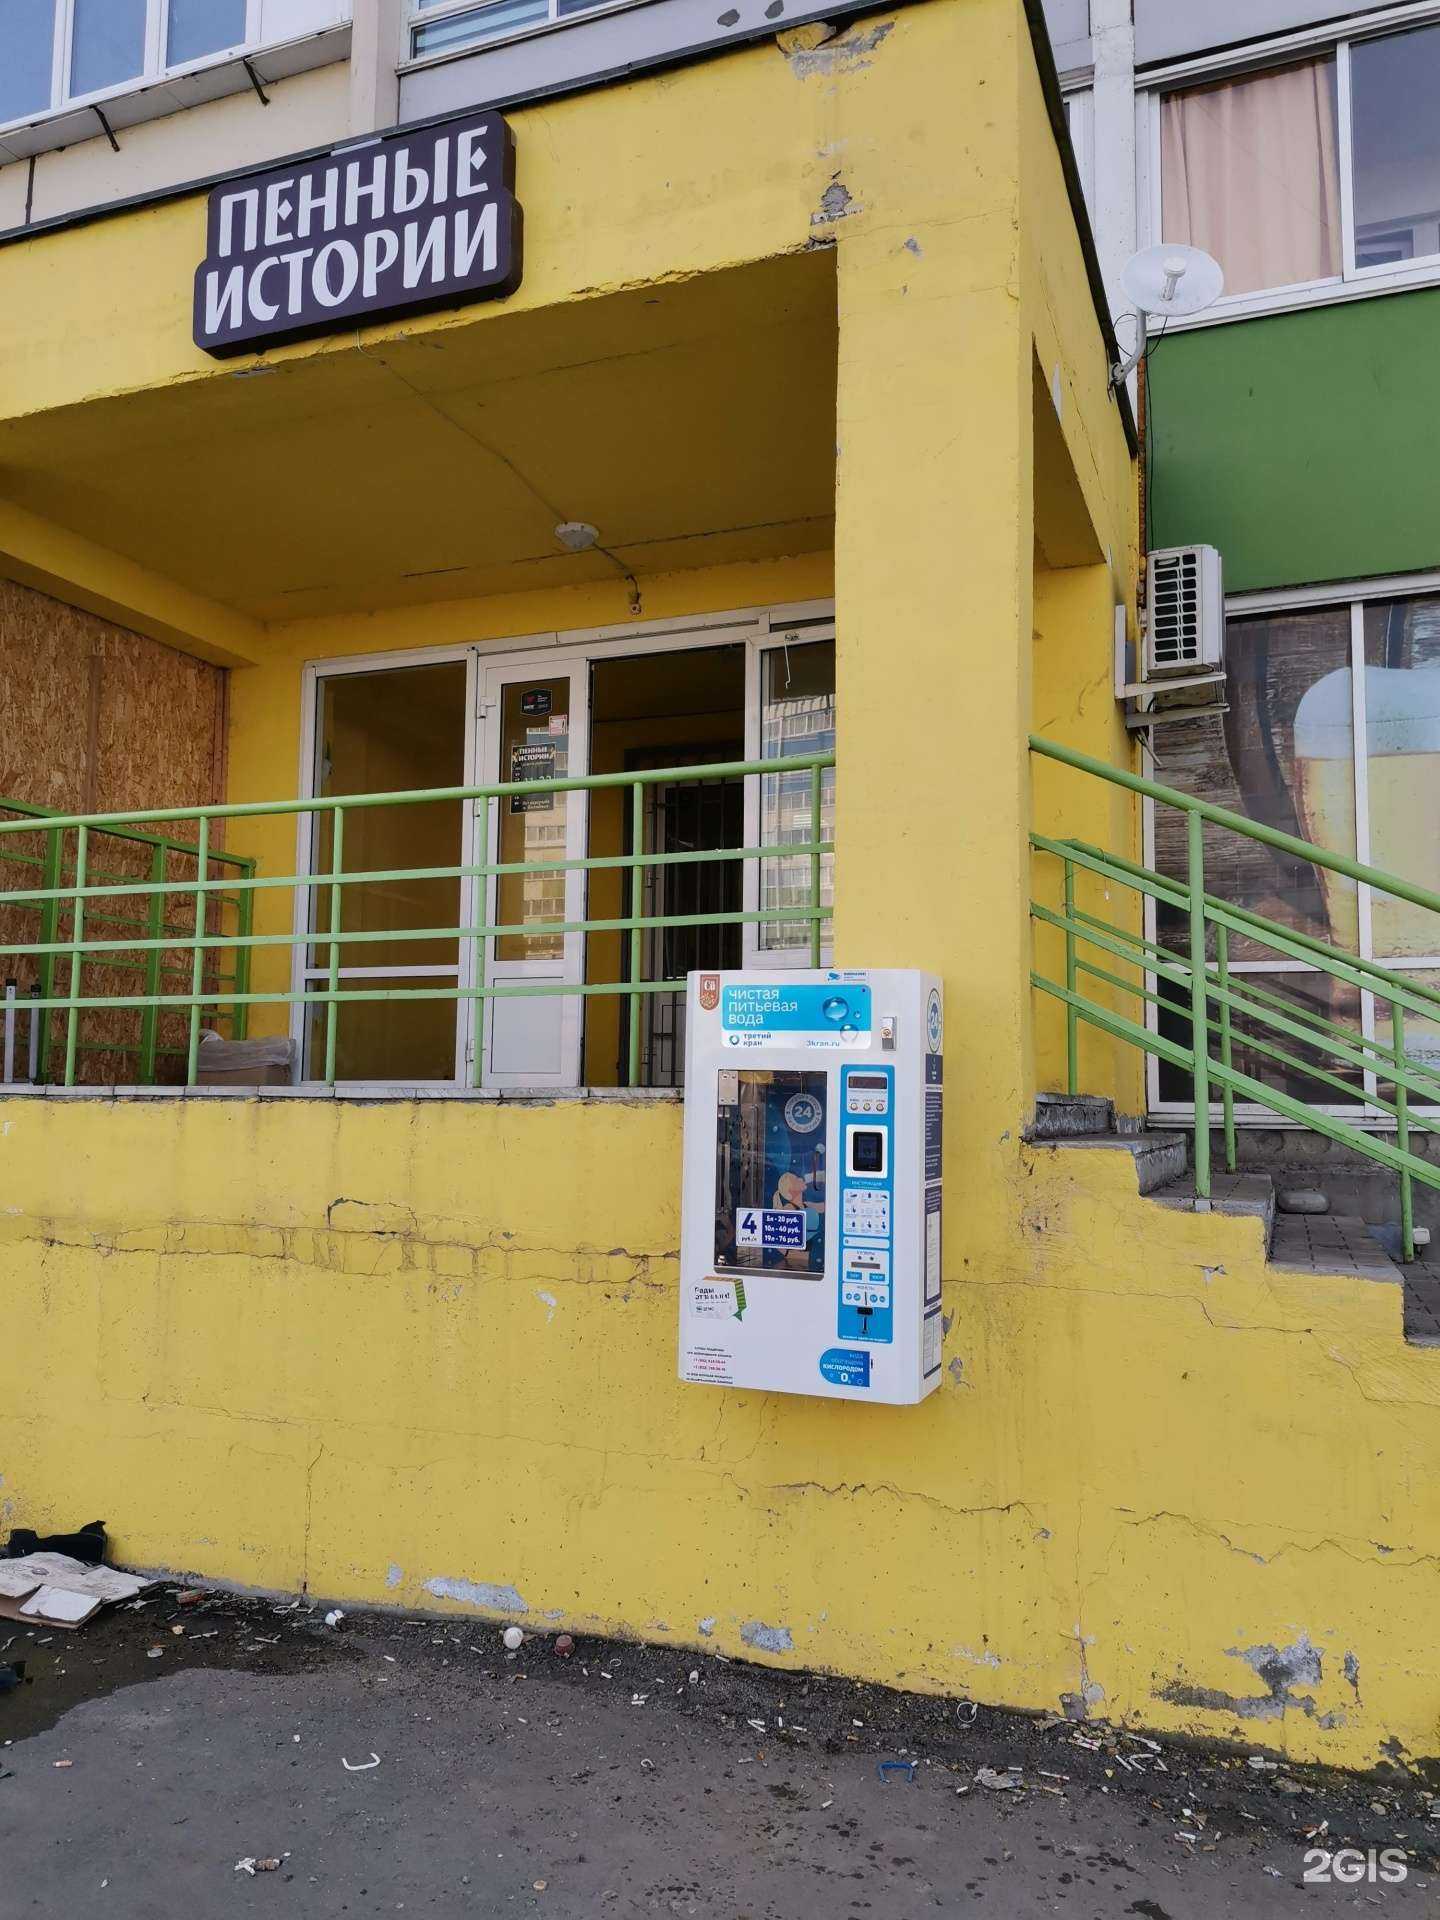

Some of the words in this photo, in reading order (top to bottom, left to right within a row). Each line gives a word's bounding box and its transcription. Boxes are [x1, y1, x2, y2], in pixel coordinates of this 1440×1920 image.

[219, 126, 489, 257] ПЕННЫЕ
[205, 202, 498, 334] ИСТОРИИ
[728, 989, 779, 1000] чистая
[728, 1001, 798, 1012] питьевая
[728, 1013, 764, 1026] вода
[743, 1032, 772, 1040] третий
[806, 1039, 840, 1048] 3kran.ru
[794, 1105, 812, 1118] 24
[741, 1212, 757, 1234] 4
[822, 1363, 864, 1373] КИСЛОРОДОМ
